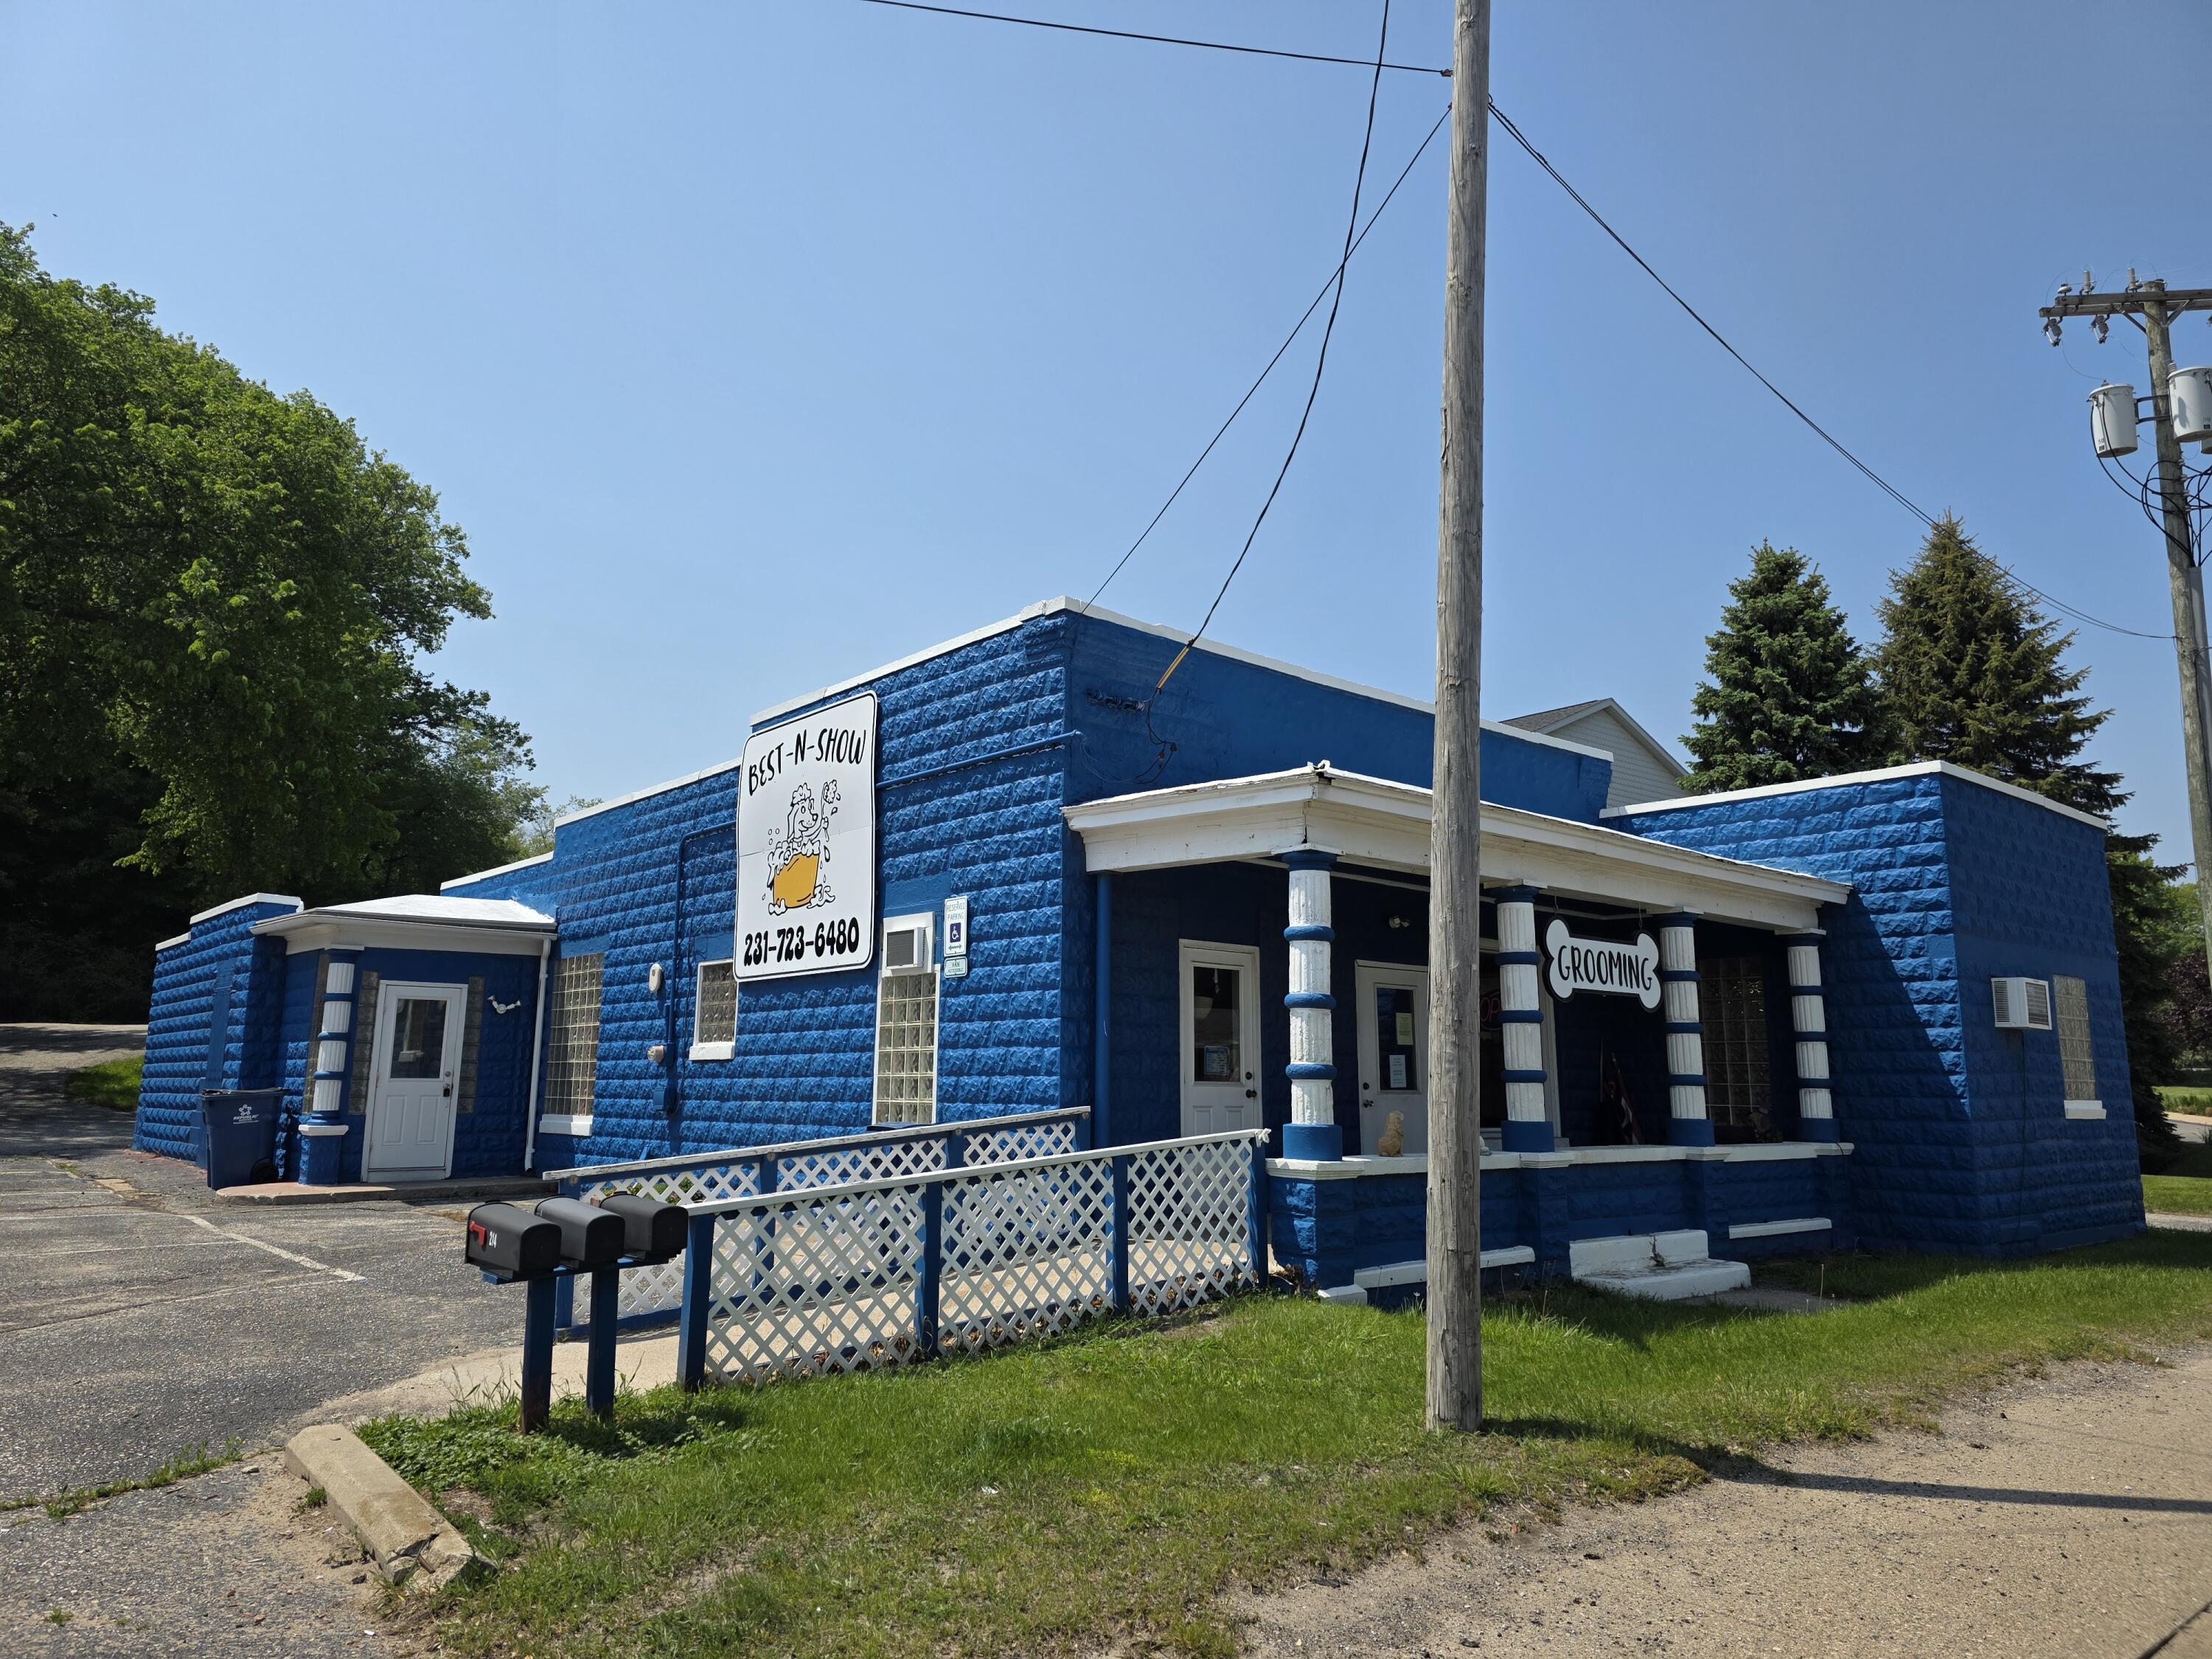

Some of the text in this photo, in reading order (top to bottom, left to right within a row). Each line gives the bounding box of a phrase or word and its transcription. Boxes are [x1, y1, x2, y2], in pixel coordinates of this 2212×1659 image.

[748, 728, 866, 796] BEST-N-SHOW
[947, 911, 964, 921] PARKING
[743, 917, 860, 967] 231-723-6480
[1557, 945, 1652, 991] GROOMING
